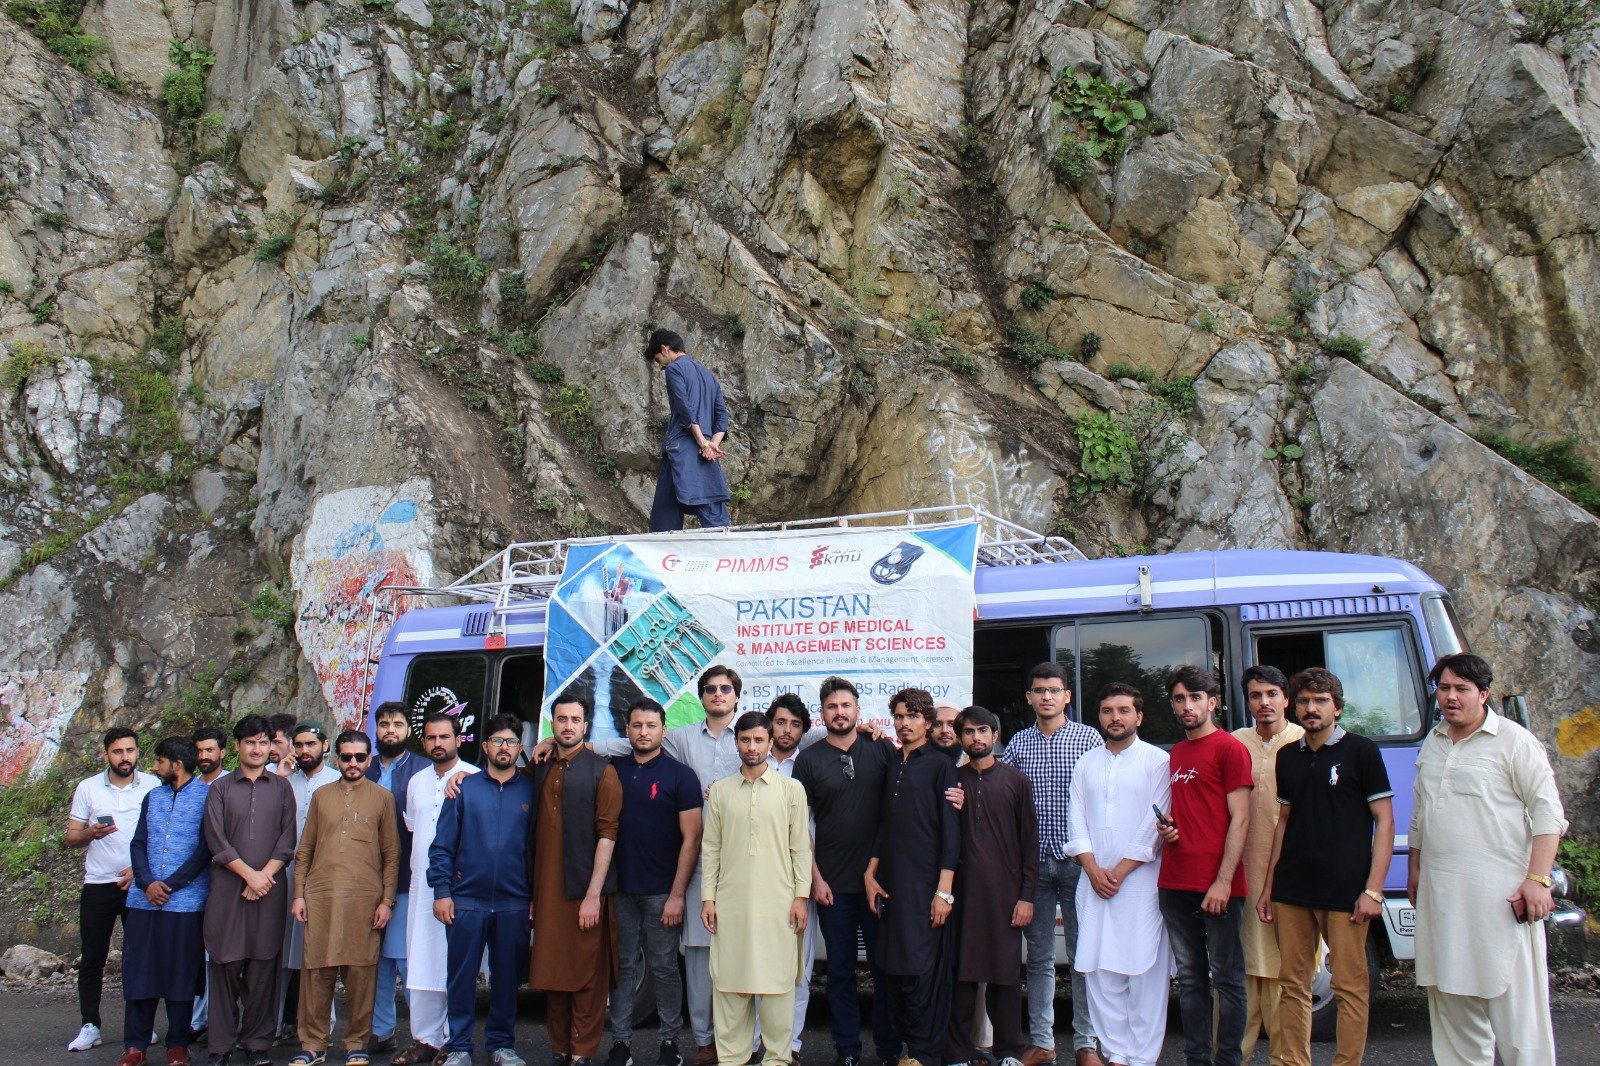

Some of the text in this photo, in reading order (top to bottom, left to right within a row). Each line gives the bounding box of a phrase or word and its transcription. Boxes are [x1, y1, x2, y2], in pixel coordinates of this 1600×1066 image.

[715, 555, 789, 572] PIMMS
[823, 553, 861, 564] kmu
[736, 594, 871, 621] PAKISTAN
[737, 619, 914, 637] INSTITUTE OF MEDICAL
[736, 636, 946, 655] & MANAGEMENT SCIENCES
[735, 656, 775, 667] Committed
[786, 656, 825, 666] Excellence
[835, 655, 859, 664] Health
[860, 655, 867, 663] &
[868, 654, 918, 665] Management
[920, 653, 954, 663] Sciences
[753, 686, 770, 697] BS
[855, 683, 873, 695] BS
